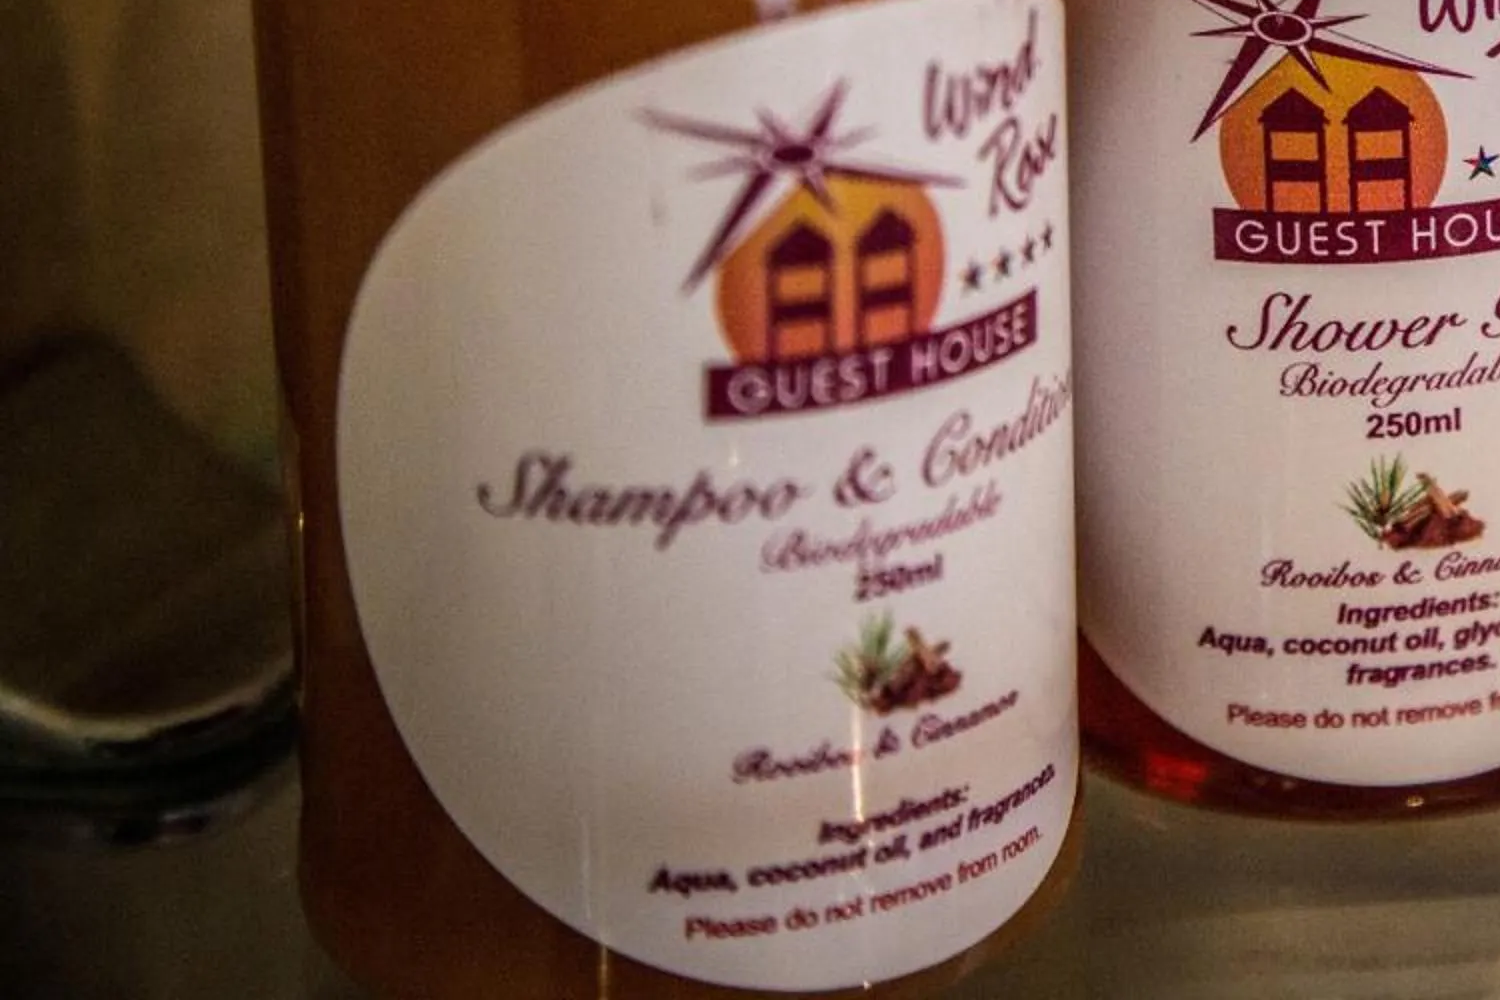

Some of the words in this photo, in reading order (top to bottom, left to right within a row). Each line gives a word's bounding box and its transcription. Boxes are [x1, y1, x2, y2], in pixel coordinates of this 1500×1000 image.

[976, 112, 1057, 218] Rose
[1235, 219, 1385, 256] GUEST
[1226, 291, 1468, 353] Shower
[728, 348, 893, 412] GUEST
[911, 304, 1029, 383] HOUSE
[1366, 408, 1462, 440] 250ml
[478, 449, 805, 551] Shampoo
[832, 446, 897, 506] &
[854, 553, 944, 601] 250ml
[1260, 558, 1386, 590] Rooibos
[1393, 560, 1424, 586] &
[1337, 590, 1500, 631] Ingredients:
[1198, 626, 1275, 657] Aqua,
[1284, 632, 1398, 657] coconut
[1404, 627, 1445, 654] oil,
[1346, 653, 1497, 690] fragrances.
[1227, 704, 1306, 730] Please
[1314, 707, 1344, 730] do
[1351, 705, 1389, 728] not
[1396, 696, 1482, 726] remove
[817, 783, 970, 845] Ingredients:
[648, 863, 738, 897] Aqua,
[746, 847, 869, 889] coconut
[873, 836, 911, 865] oil,
[918, 813, 965, 851] and
[685, 913, 779, 941] Please
[785, 907, 818, 933] do
[825, 898, 864, 923] not
[870, 873, 953, 914] remove
[957, 853, 998, 885] from
